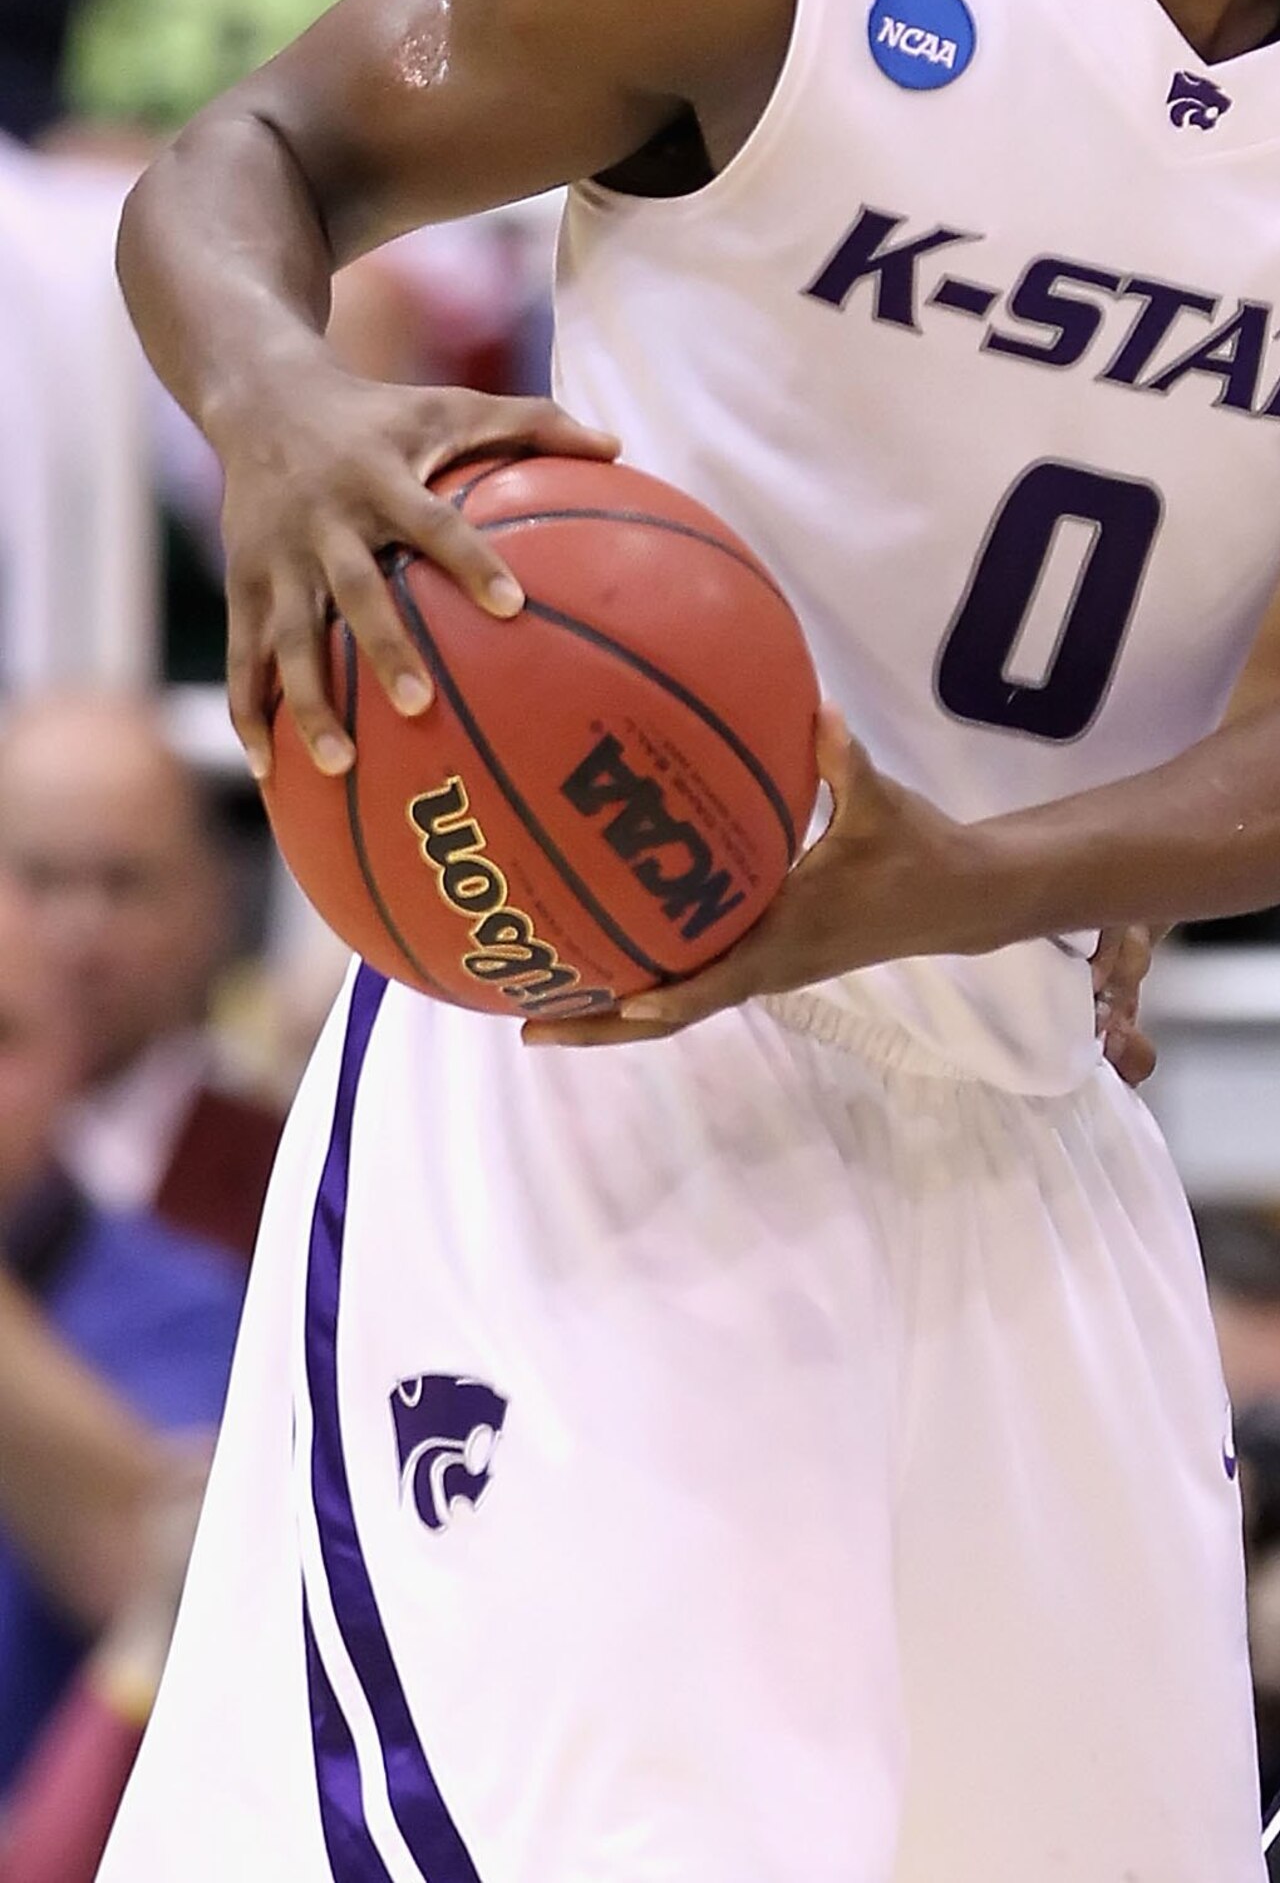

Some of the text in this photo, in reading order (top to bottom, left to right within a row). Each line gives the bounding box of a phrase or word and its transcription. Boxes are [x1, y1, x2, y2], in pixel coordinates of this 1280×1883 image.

[877, 15, 957, 69] NCAA
[931, 455, 1166, 747] 0
[560, 732, 746, 941] NCAA
